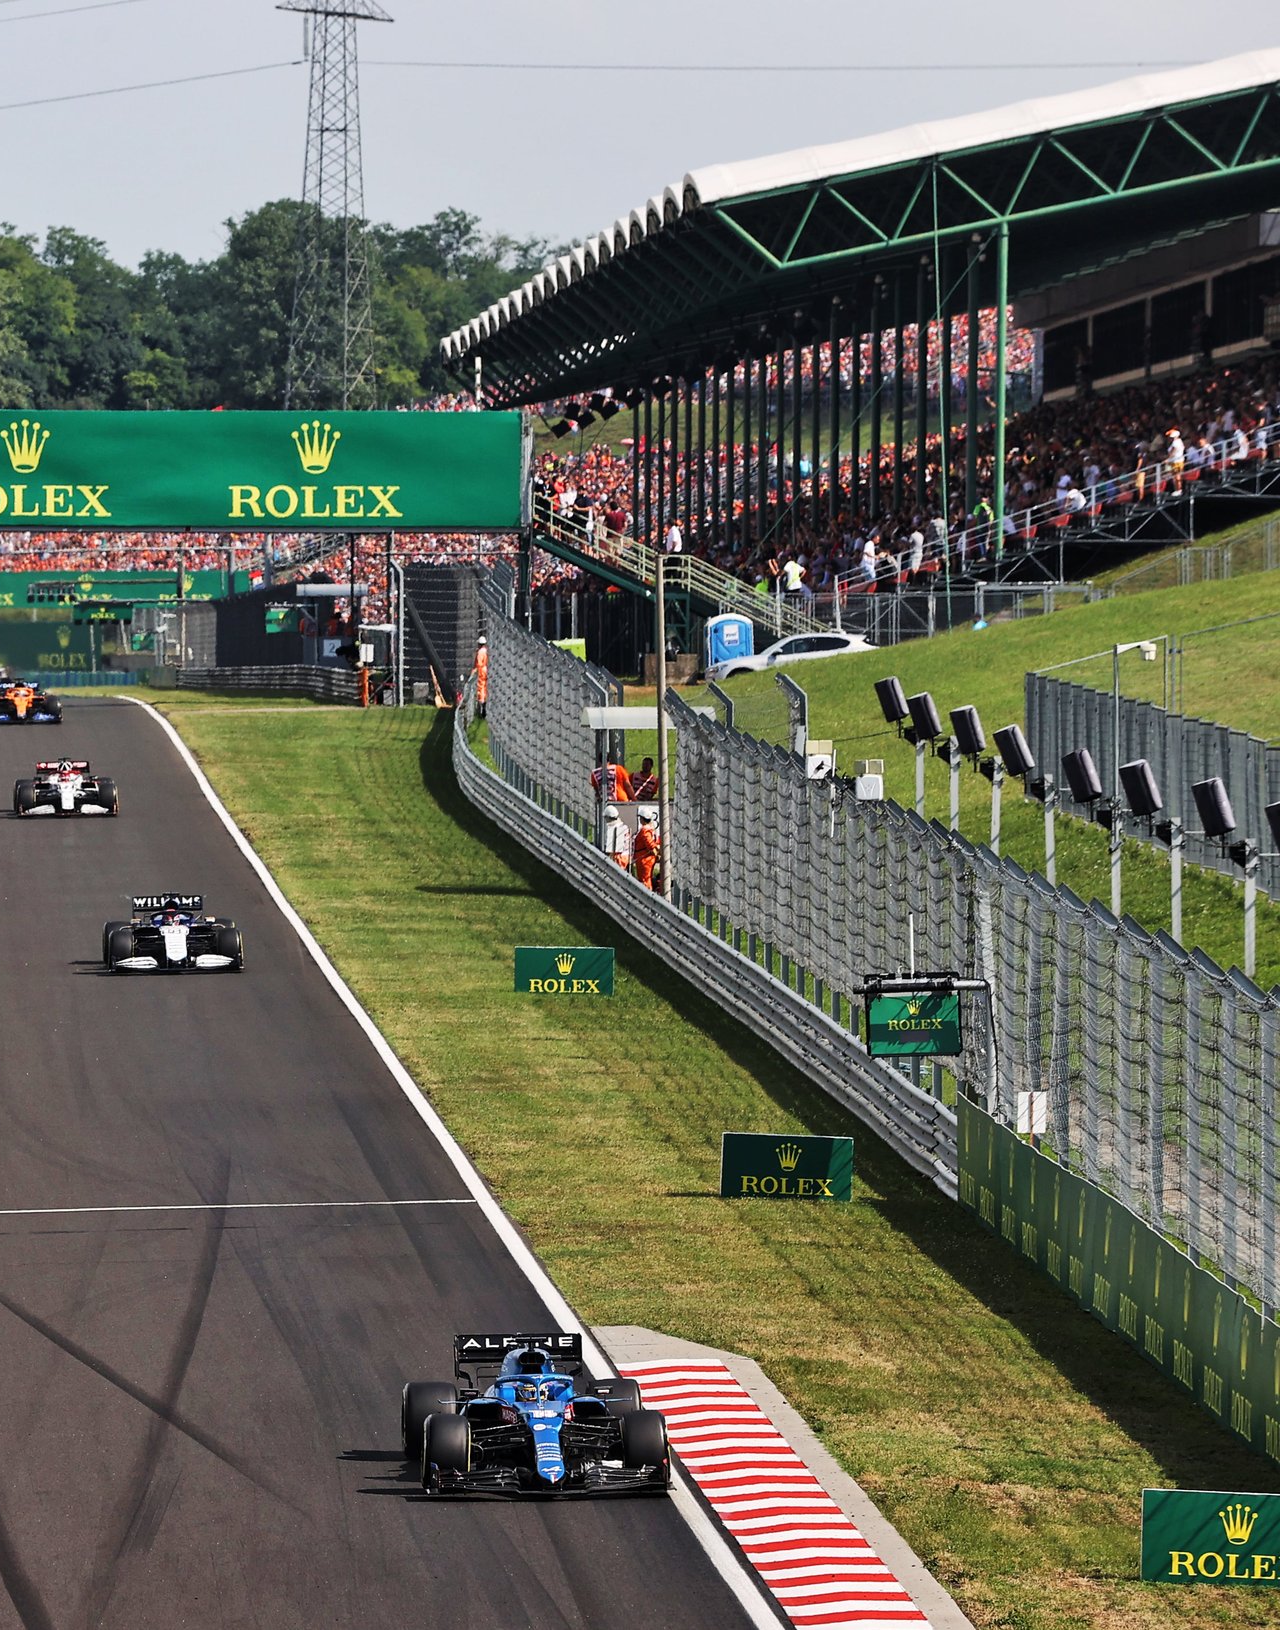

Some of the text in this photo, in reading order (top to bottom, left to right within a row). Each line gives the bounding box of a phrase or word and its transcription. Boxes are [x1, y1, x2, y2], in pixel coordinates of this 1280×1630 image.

[228, 484, 403, 518] ROLEX
[528, 978, 600, 994] ROLEX
[888, 1018, 943, 1031] ROLEX
[740, 1175, 834, 1197] ROLEX
[463, 1337, 573, 1349] ALPNE
[1168, 1551, 1280, 1580] ROLE
